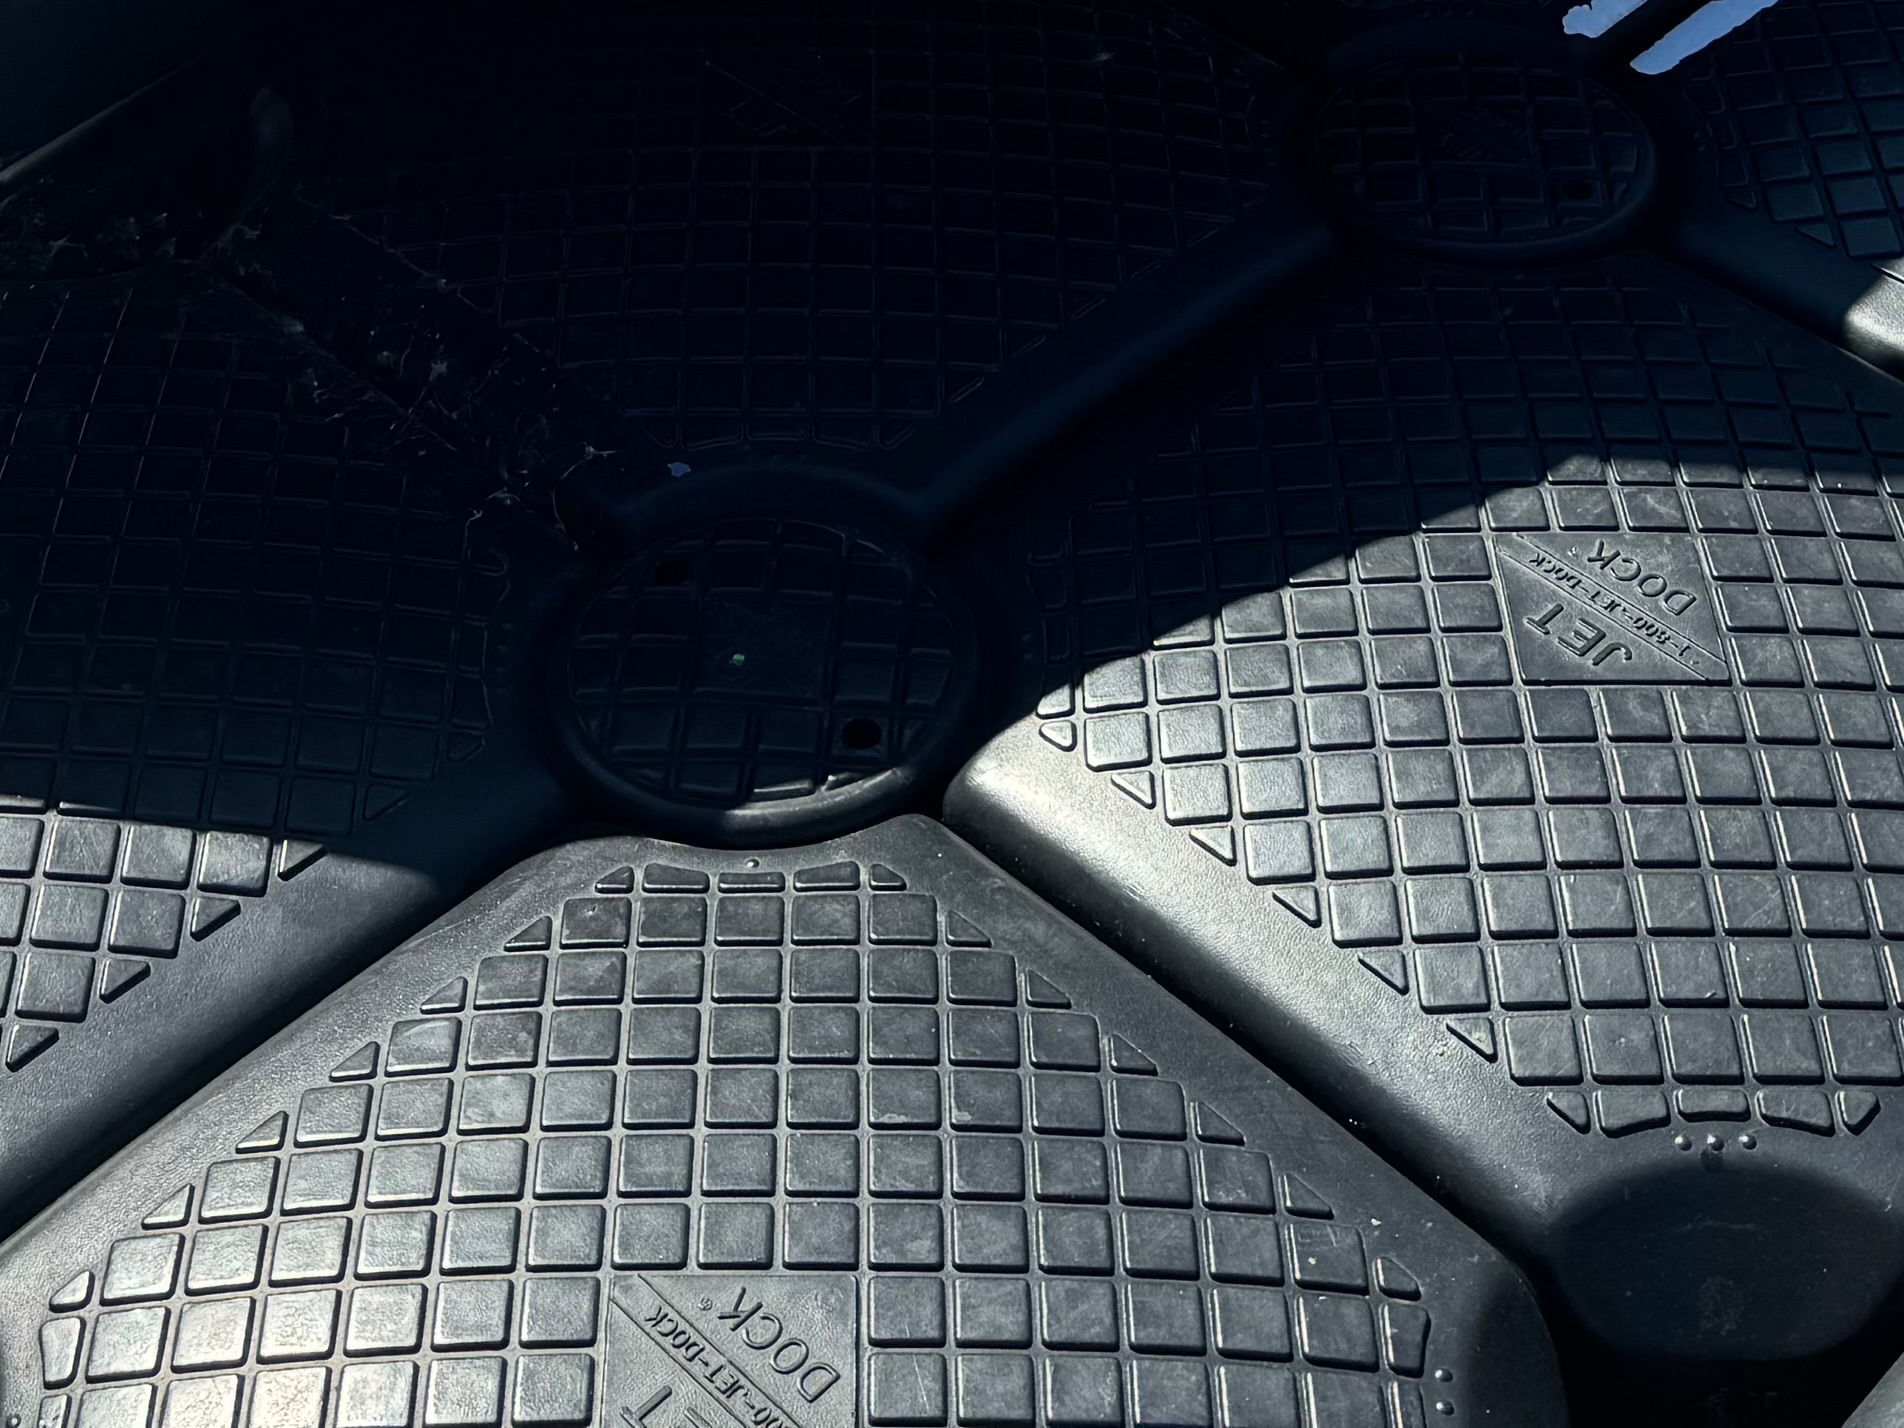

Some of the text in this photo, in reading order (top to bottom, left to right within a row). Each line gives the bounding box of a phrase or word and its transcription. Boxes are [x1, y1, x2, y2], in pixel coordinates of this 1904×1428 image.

[1530, 553, 1691, 657] 1-800-JET-DOCK
[1588, 539, 1697, 617] DOCK
[1524, 603, 1634, 667] JET
[718, 1287, 841, 1404] DOCK
